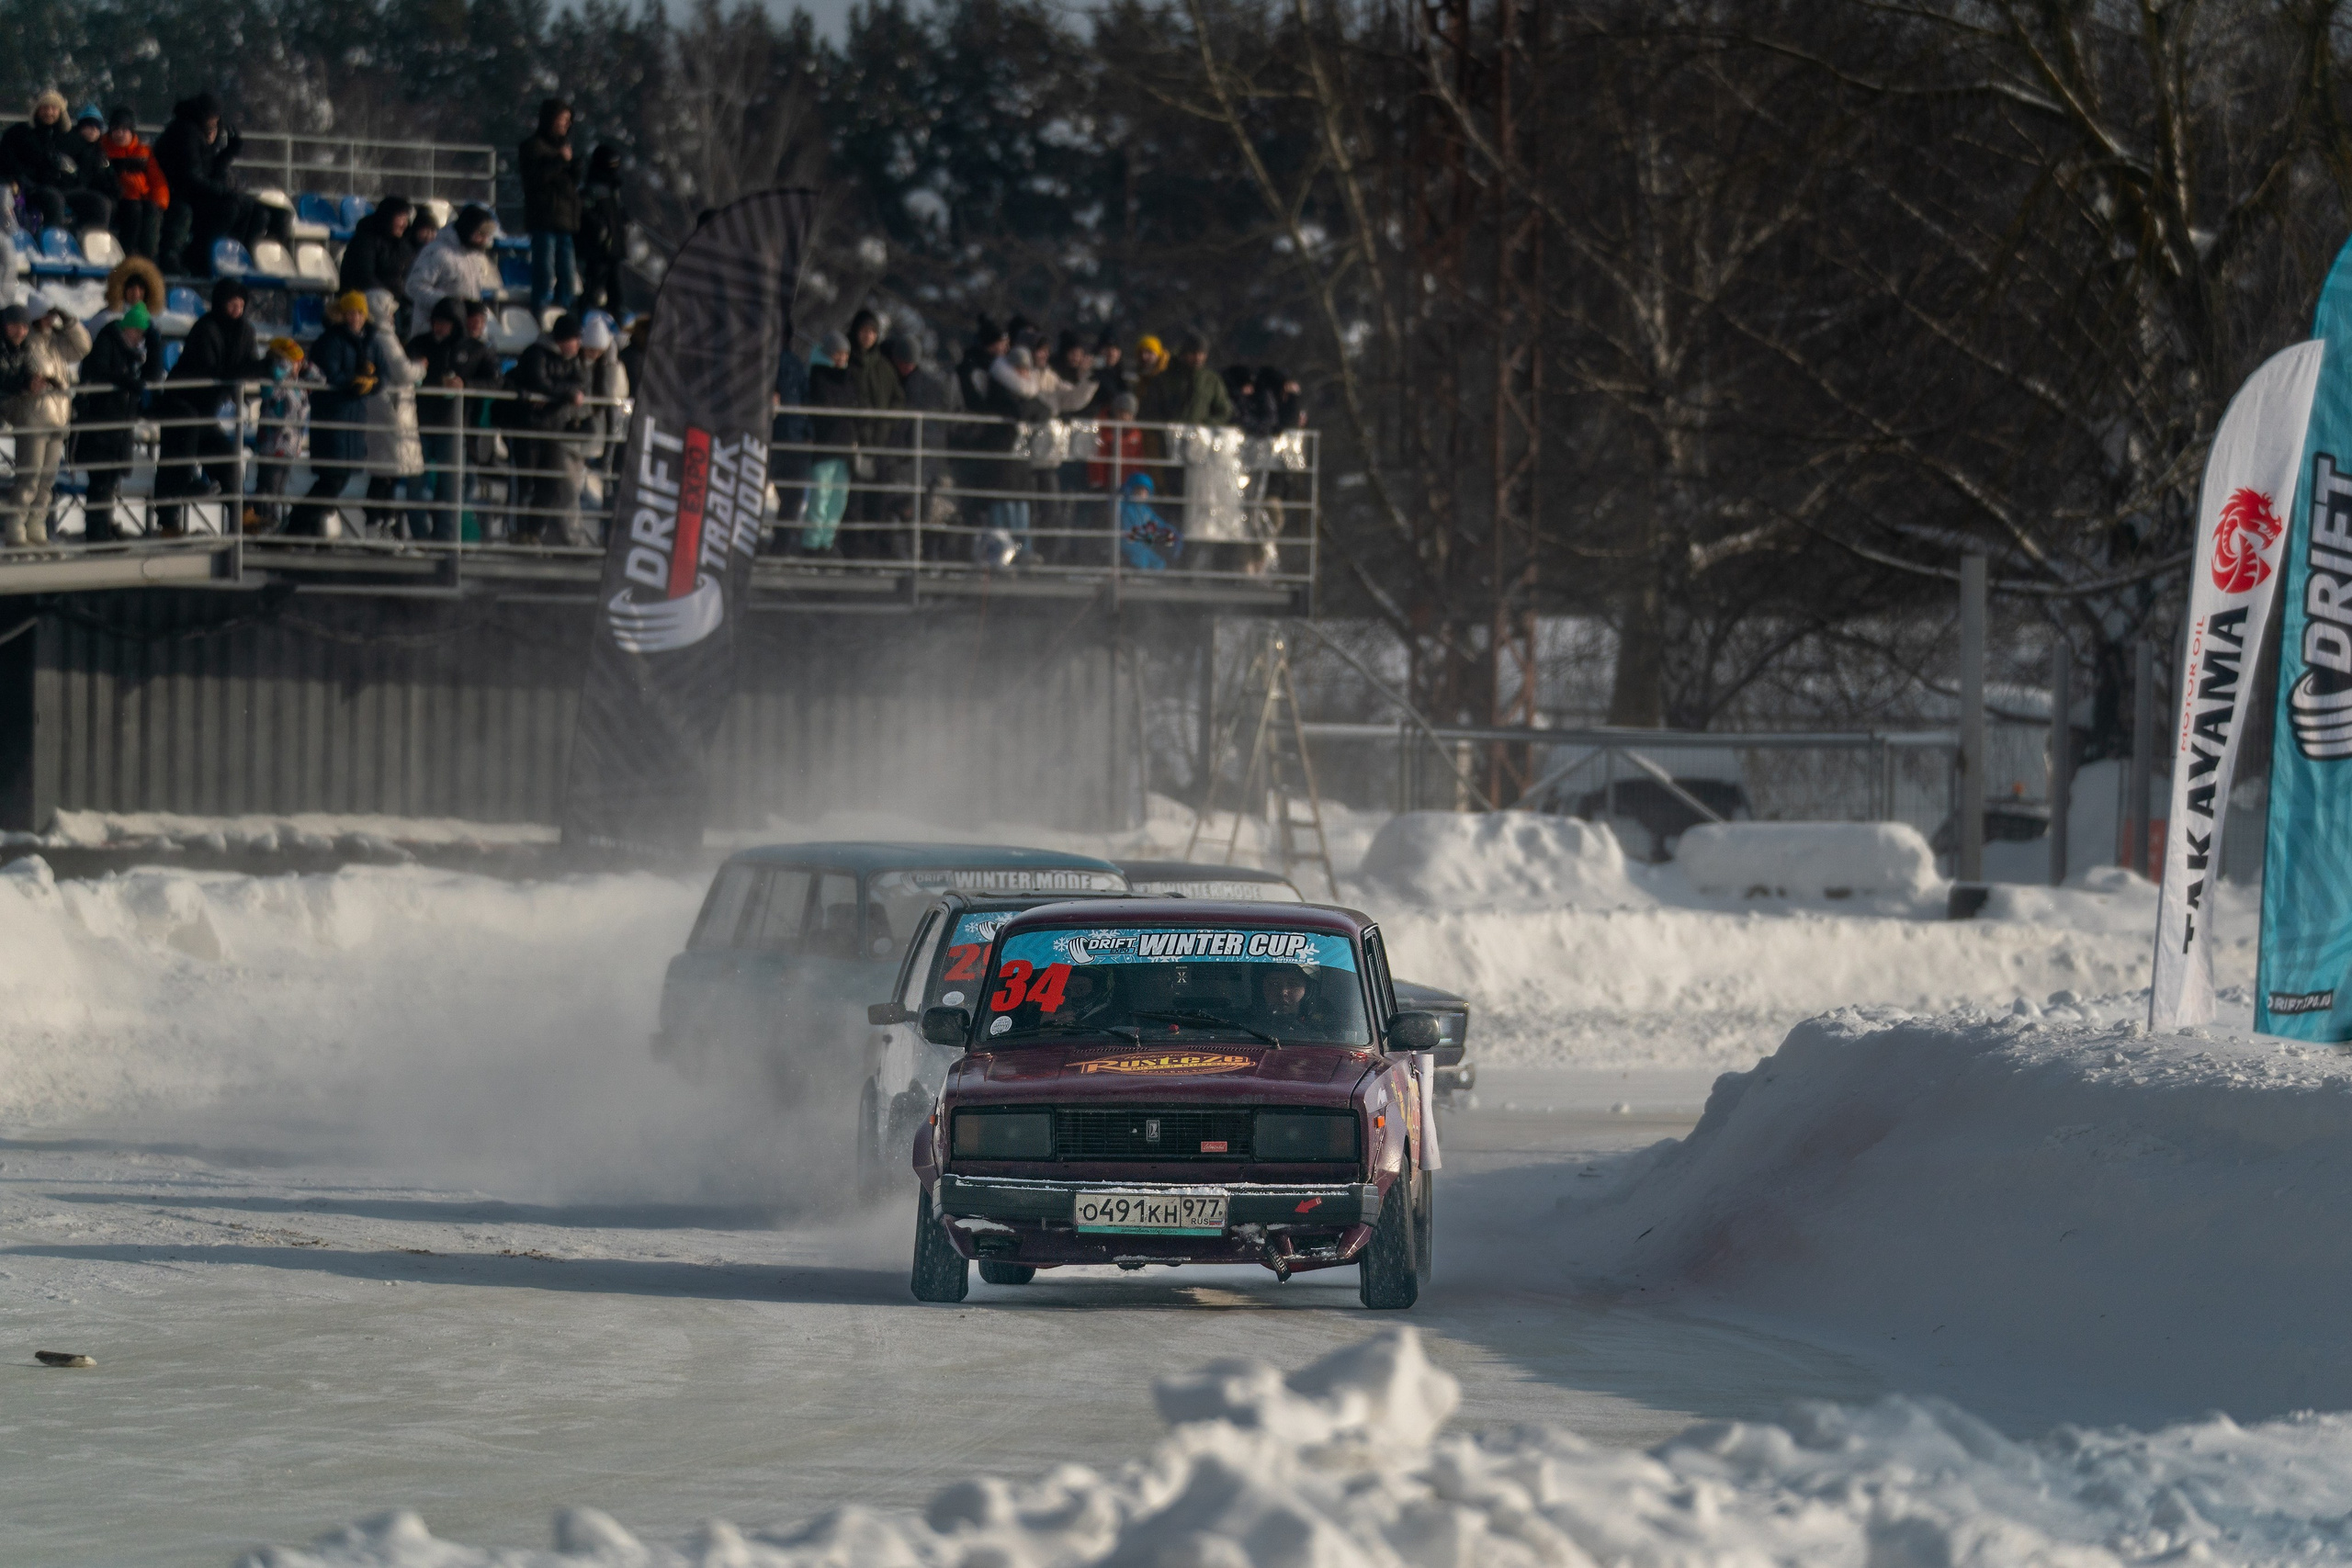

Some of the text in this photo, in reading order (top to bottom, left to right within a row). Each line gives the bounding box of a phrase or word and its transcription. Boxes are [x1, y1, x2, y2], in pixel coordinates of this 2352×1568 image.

[626, 416, 684, 589] DRIFT
[2181, 615, 2205, 752] MOTOR OIL
[2182, 605, 2249, 954] TAKAYAMA
[955, 871, 1091, 889] WINTER MODE
[1088, 938, 1136, 949] DRIFT
[1139, 933, 1306, 956] WINTER CUP
[990, 959, 1073, 1013] 34
[1182, 1199, 1219, 1218] 977
[1191, 1217, 1209, 1225] RUS
